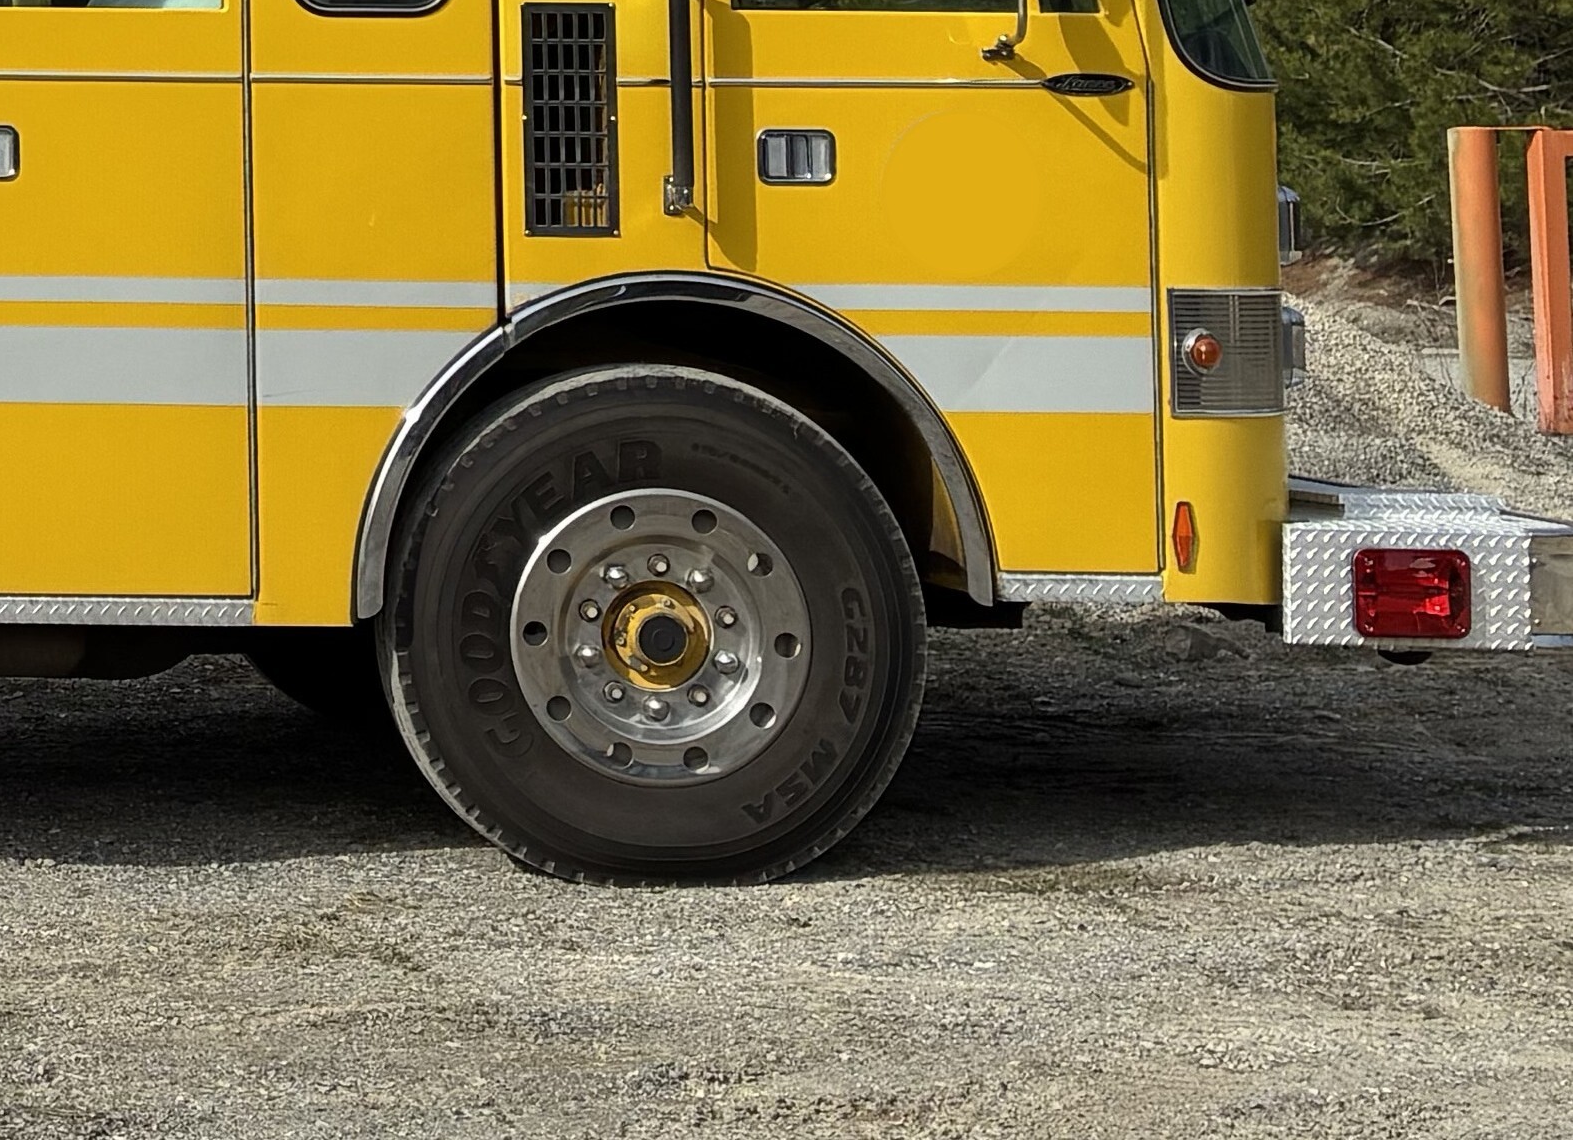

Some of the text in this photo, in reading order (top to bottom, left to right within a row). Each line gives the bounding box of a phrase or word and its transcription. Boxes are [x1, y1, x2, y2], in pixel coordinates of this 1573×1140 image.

[459, 437, 664, 760] GOODYEAR
[740, 587, 869, 826] G287 MSA
